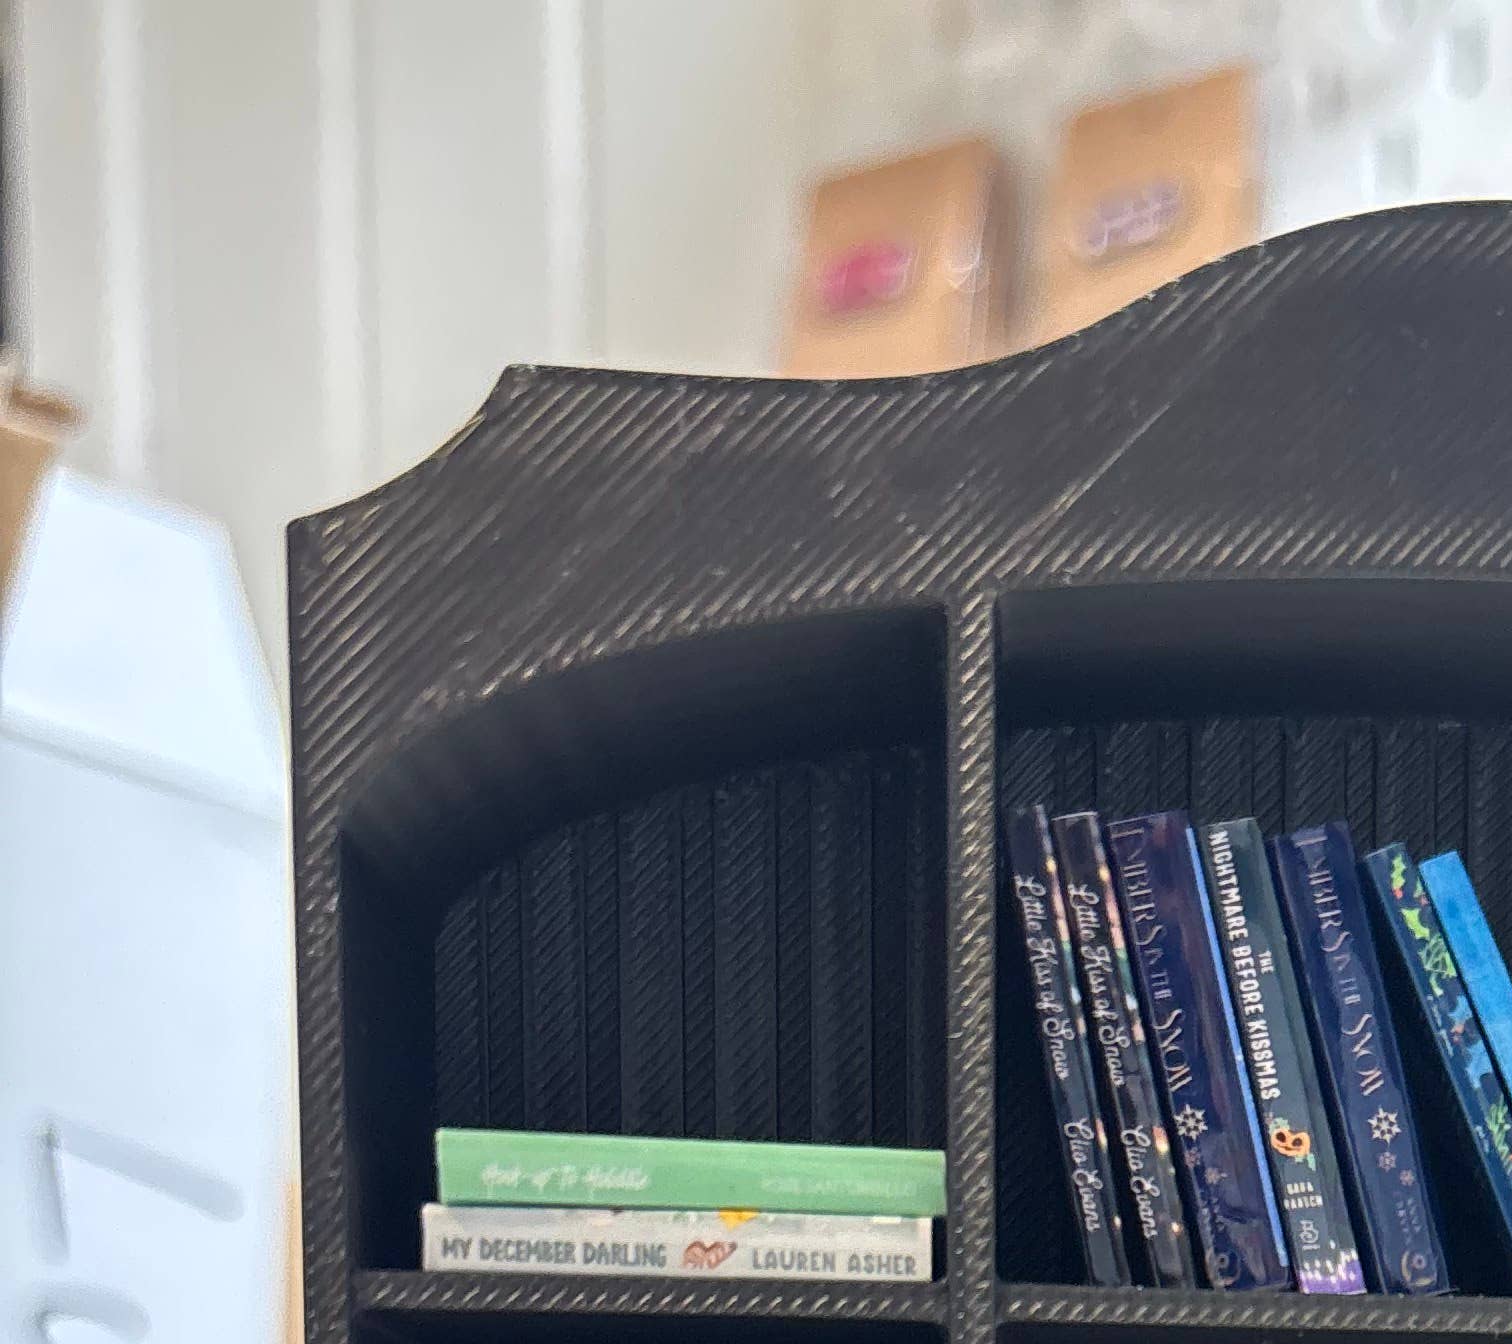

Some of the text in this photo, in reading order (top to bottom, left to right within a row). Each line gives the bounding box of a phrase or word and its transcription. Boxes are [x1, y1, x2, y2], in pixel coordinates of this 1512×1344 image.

[1013, 871, 1080, 1081] Little Kiss of Snow
[1067, 880, 1135, 1087] Little Kiss of Snow
[1207, 831, 1280, 1100] NIGHTMARE BEFORE KISSMAS
[1258, 951, 1273, 973] THE
[1065, 1119, 1109, 1231] Clio Evans
[1122, 1126, 1165, 1236] Clio Evans
[441, 1237, 667, 1268] MY DECEMBER DARLING
[752, 1247, 917, 1276] LAUREN ASHER
